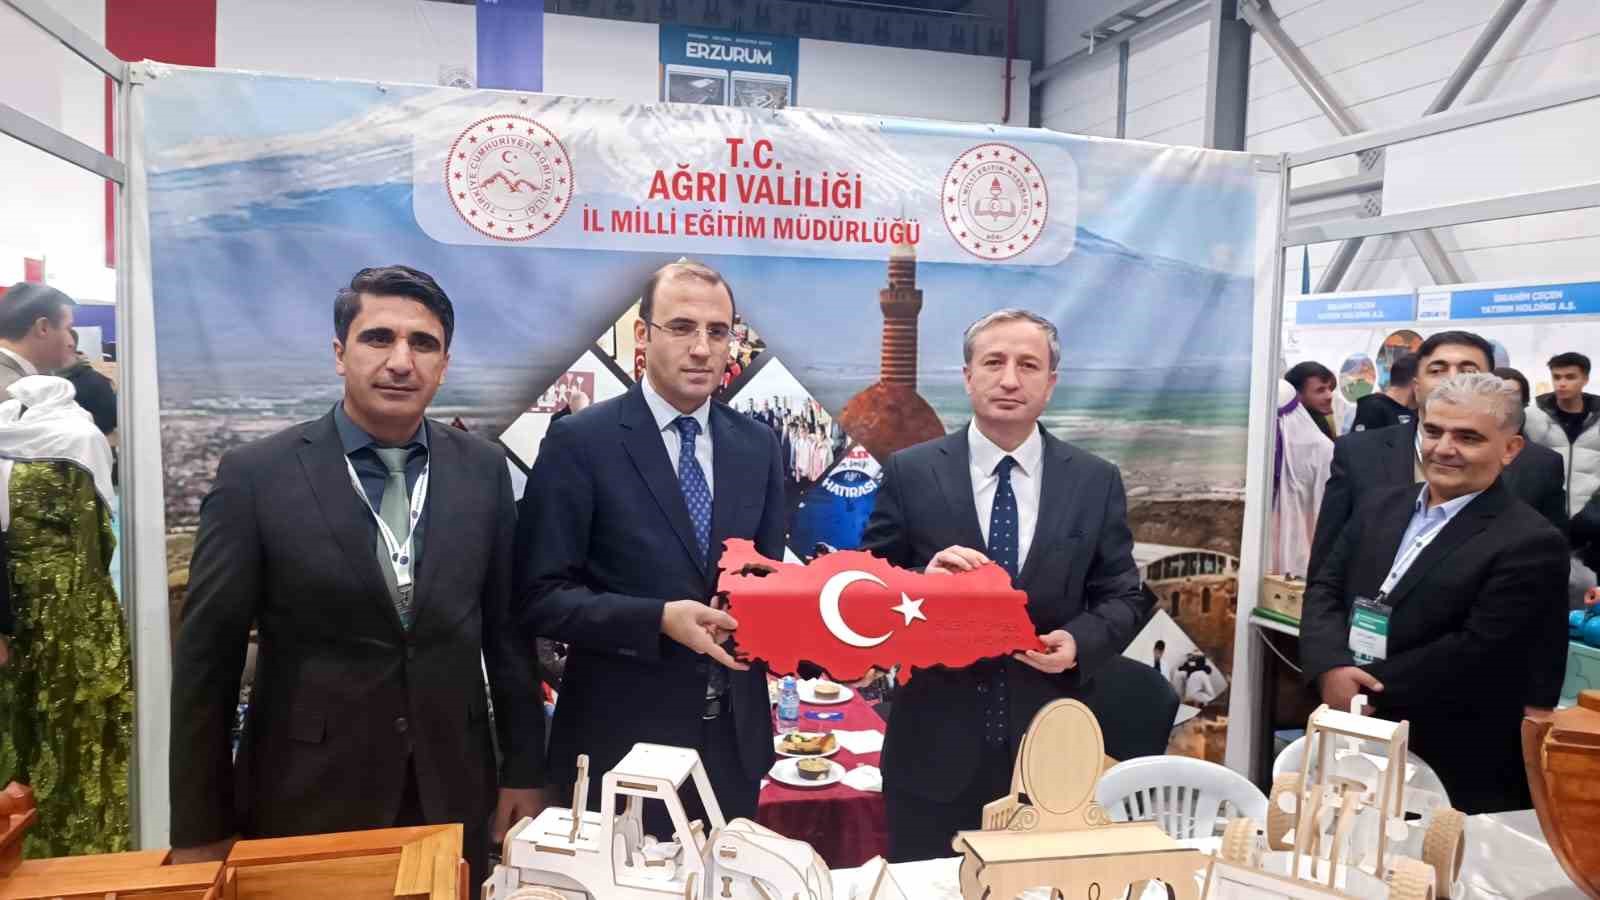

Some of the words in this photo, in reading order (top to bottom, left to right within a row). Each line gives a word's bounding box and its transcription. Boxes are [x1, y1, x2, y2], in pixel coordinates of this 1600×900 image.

[686, 42, 772, 65] ERZURUM
[726, 137, 782, 170] T.C.
[648, 162, 727, 203] AĞRI
[736, 169, 862, 209] VALİLİĞİ
[582, 203, 604, 232] İL
[611, 205, 676, 235] MİLLİ
[684, 208, 765, 239] EĞİTİM
[773, 213, 920, 245] MÜDÜRLÜĞÜ
